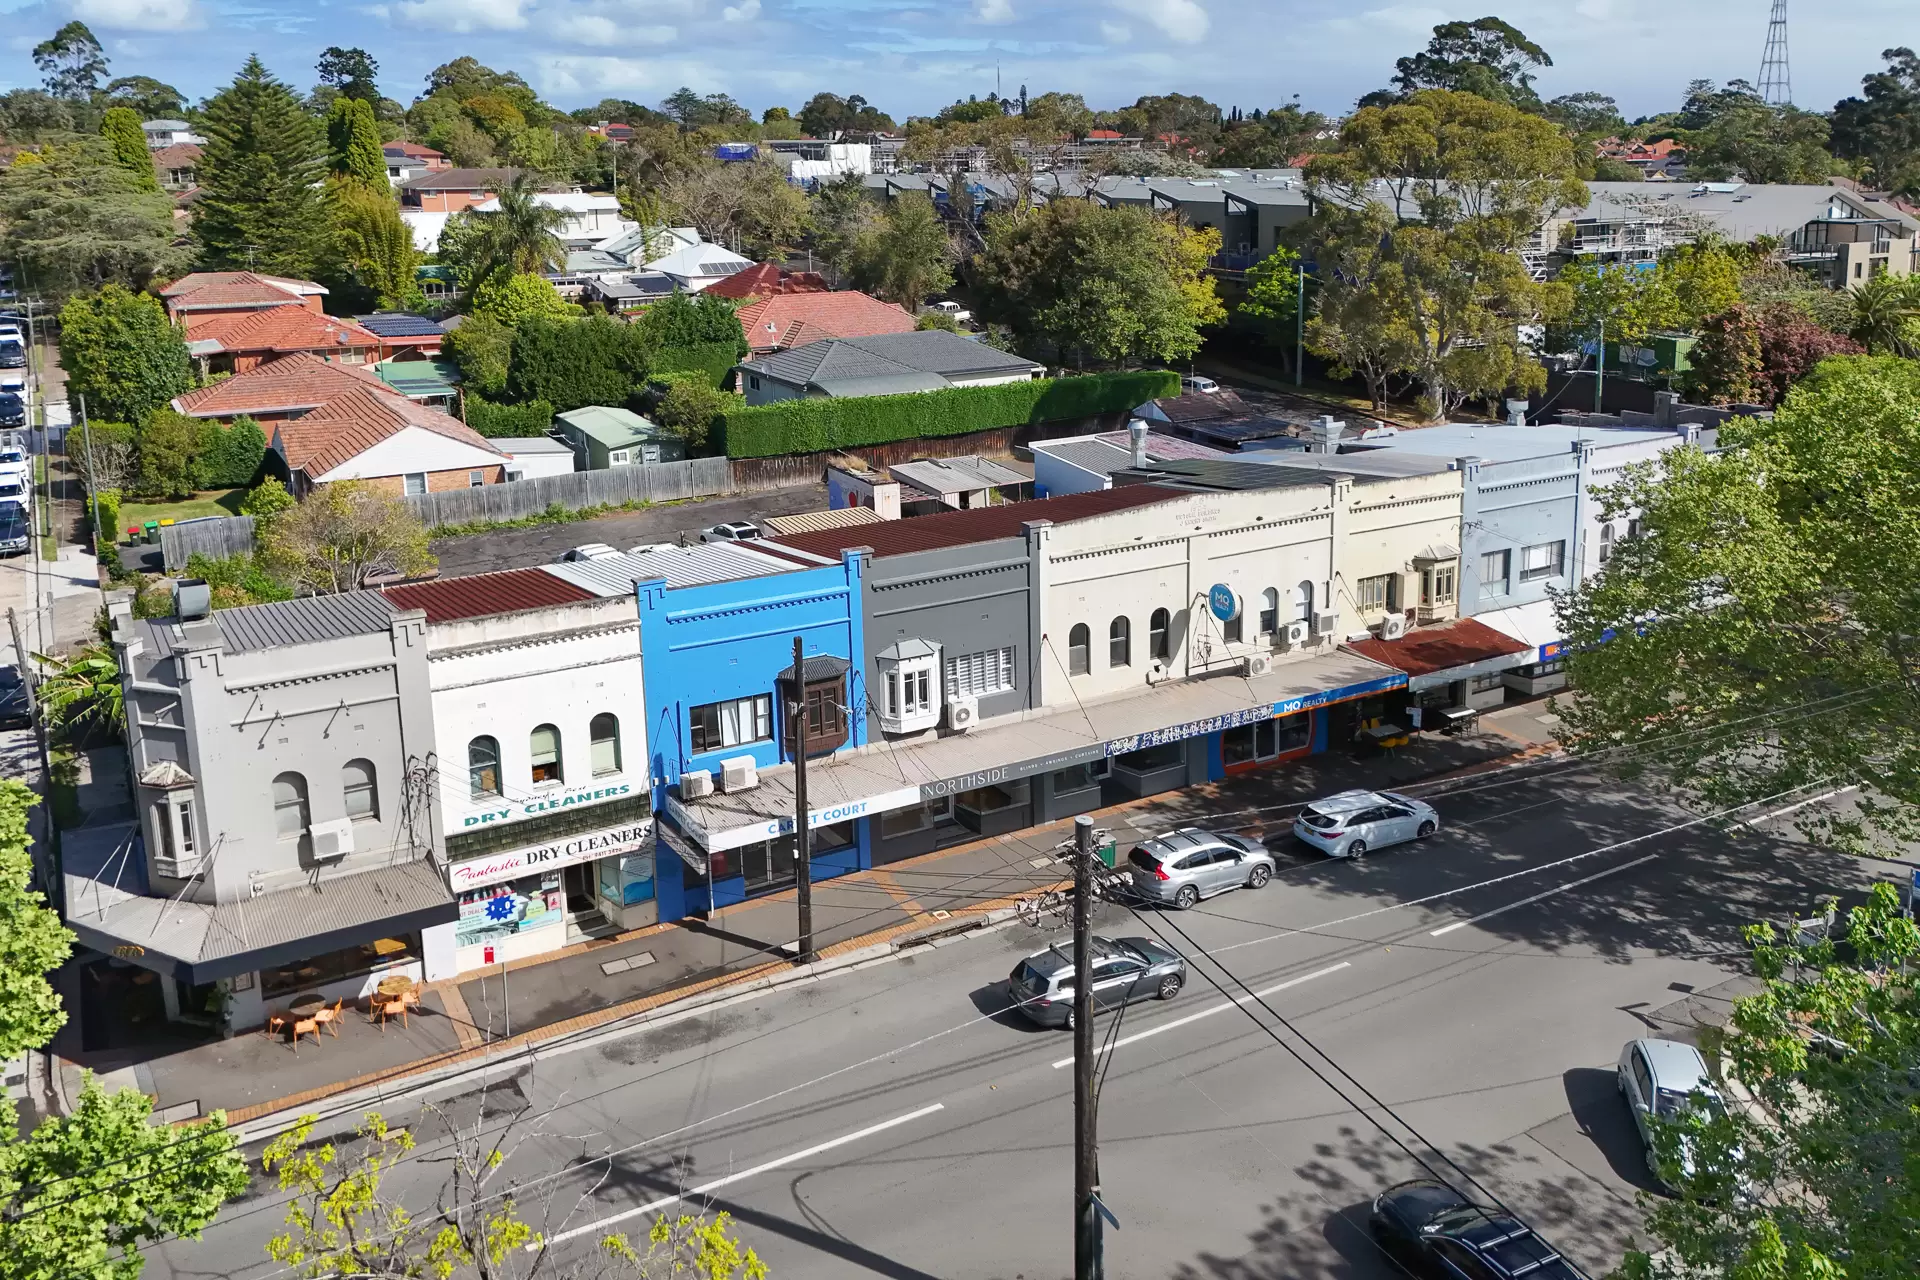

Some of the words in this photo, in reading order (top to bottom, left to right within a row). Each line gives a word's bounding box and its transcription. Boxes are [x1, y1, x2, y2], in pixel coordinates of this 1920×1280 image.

[1215, 591, 1230, 606] MQ
[1302, 696, 1327, 709] REALTY
[925, 766, 1010, 797] NORTHSIDE
[464, 809, 512, 827] DRY
[524, 784, 631, 814] CLEANERS
[768, 814, 819, 835] CARET
[823, 802, 868, 821] COURT
[454, 859, 522, 884] Fantastic
[526, 845, 561, 866] DRY
[566, 824, 653, 857] CLEANERS
